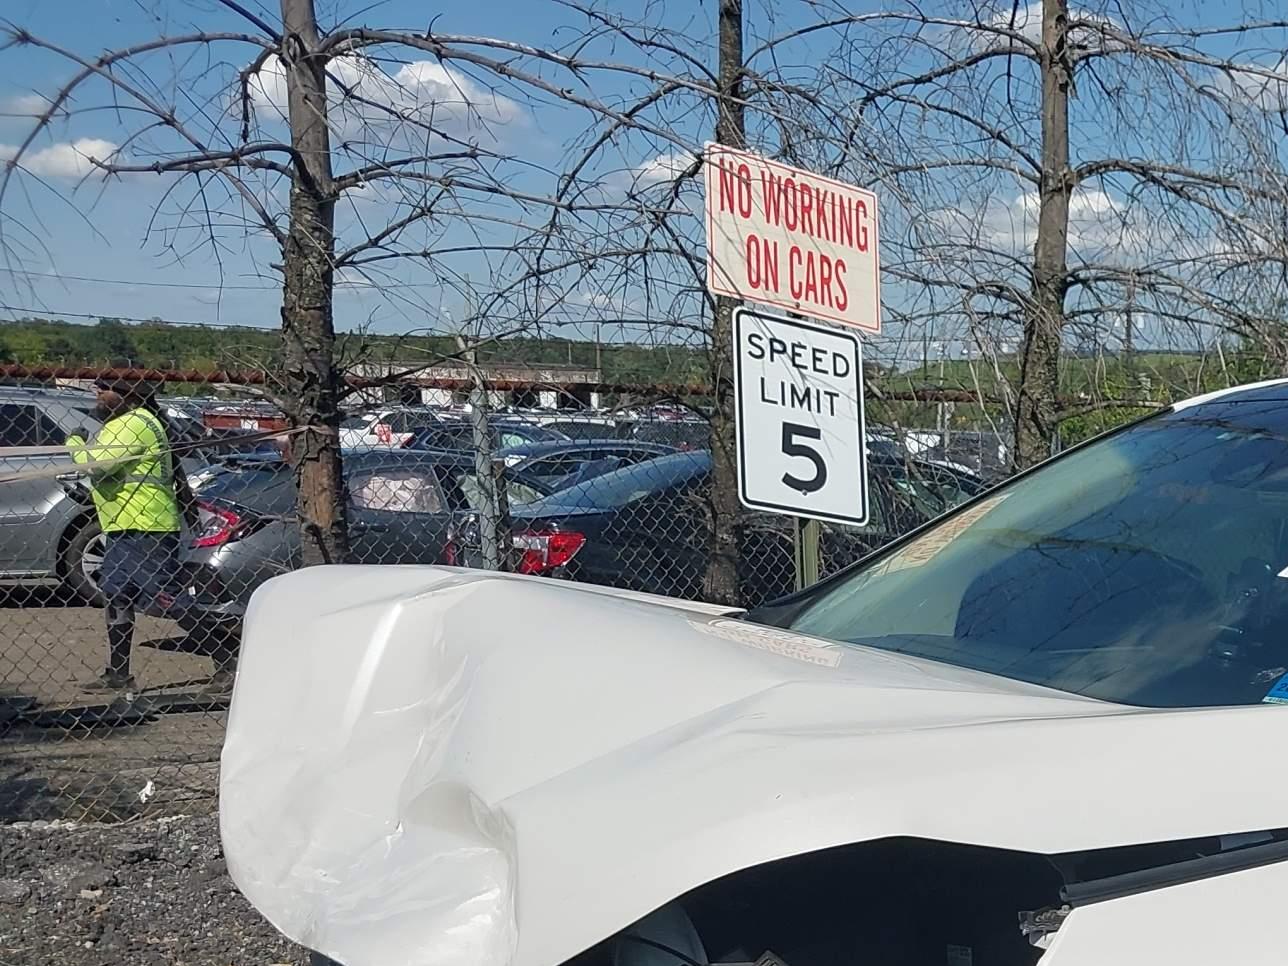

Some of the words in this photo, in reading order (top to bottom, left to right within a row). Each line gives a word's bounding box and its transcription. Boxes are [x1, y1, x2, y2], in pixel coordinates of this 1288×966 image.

[719, 158, 752, 219] NO
[761, 170, 868, 253] WORKING
[746, 233, 780, 294] ON
[789, 245, 848, 312] CARS
[747, 333, 850, 378] SPEED
[760, 376, 839, 416] LIMIT
[782, 421, 827, 493] 5
